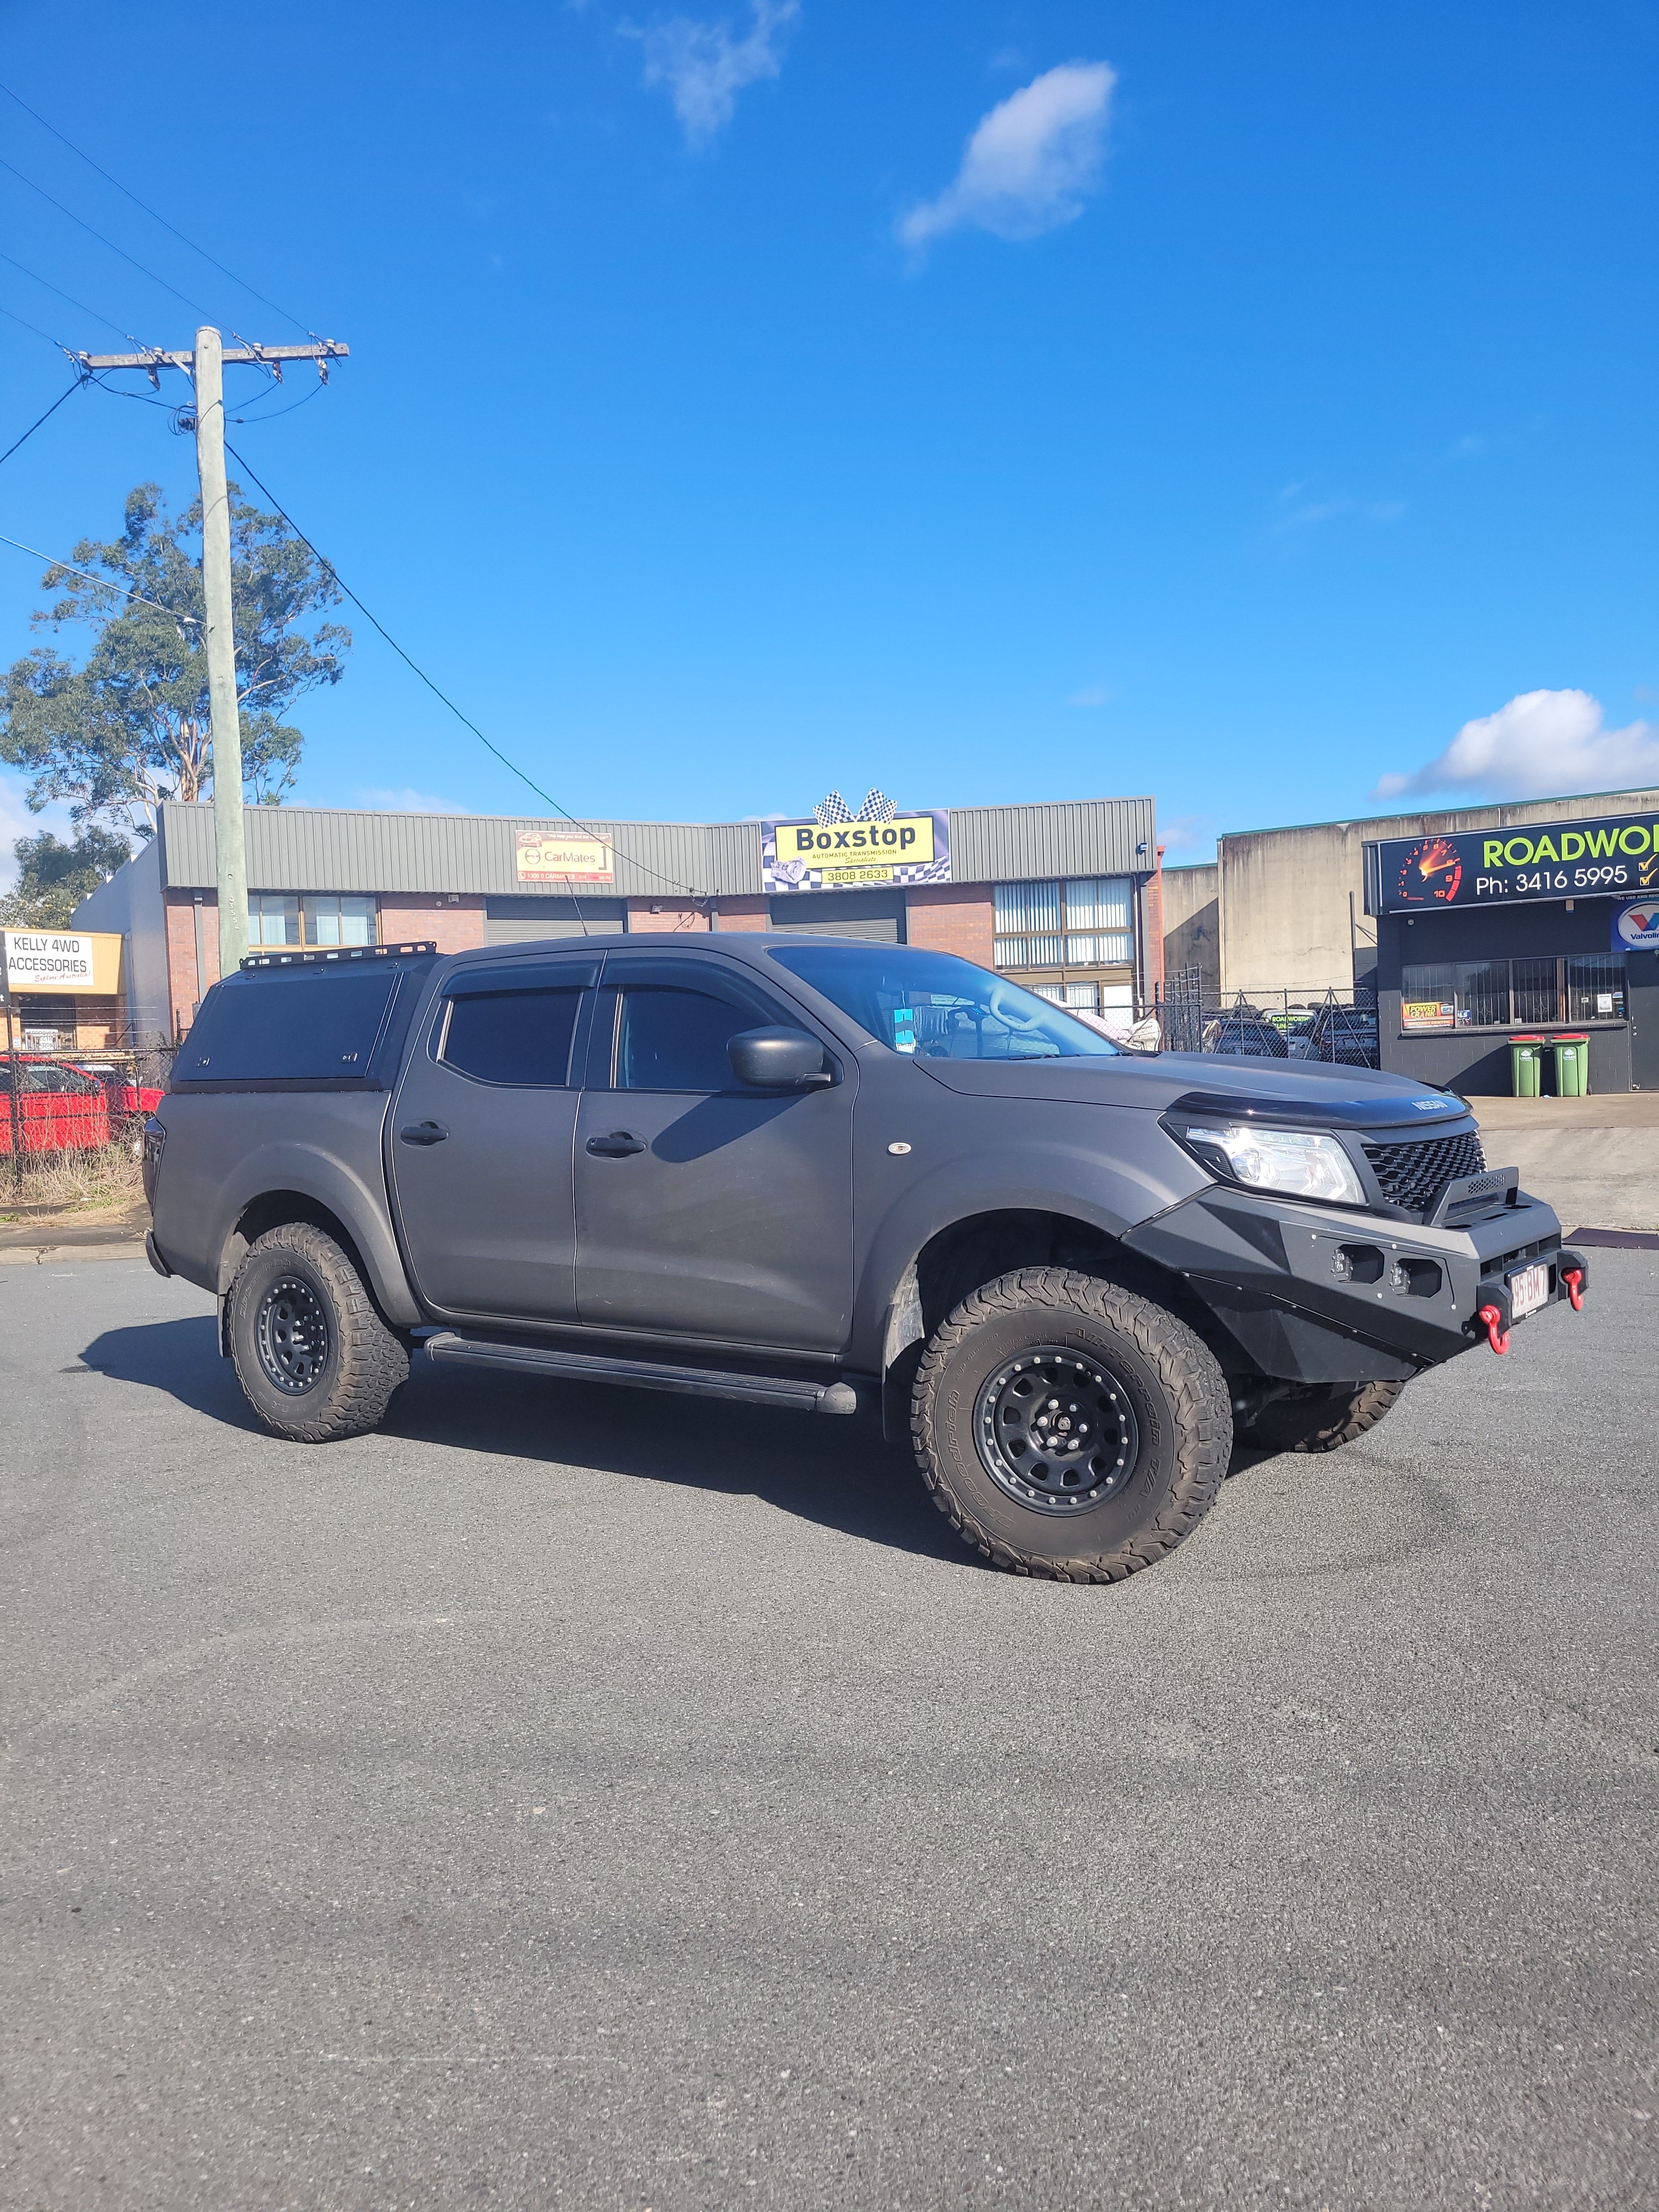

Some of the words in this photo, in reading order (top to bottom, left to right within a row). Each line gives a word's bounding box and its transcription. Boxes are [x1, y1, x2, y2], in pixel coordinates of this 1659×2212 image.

[797, 826, 916, 850] Boxstop
[545, 851, 595, 862] CarMates
[828, 871, 855, 881] 3808
[860, 870, 888, 879] 2633
[1476, 877, 1508, 895] Ph:
[1516, 871, 1567, 892] 3416
[1574, 865, 1627, 887] 5995
[14, 937, 47, 951] KELLY
[52, 939, 80, 952] 4WD
[9, 957, 87, 972] ACCESSORIES
[1412, 1100, 1448, 1110] NISSAN
